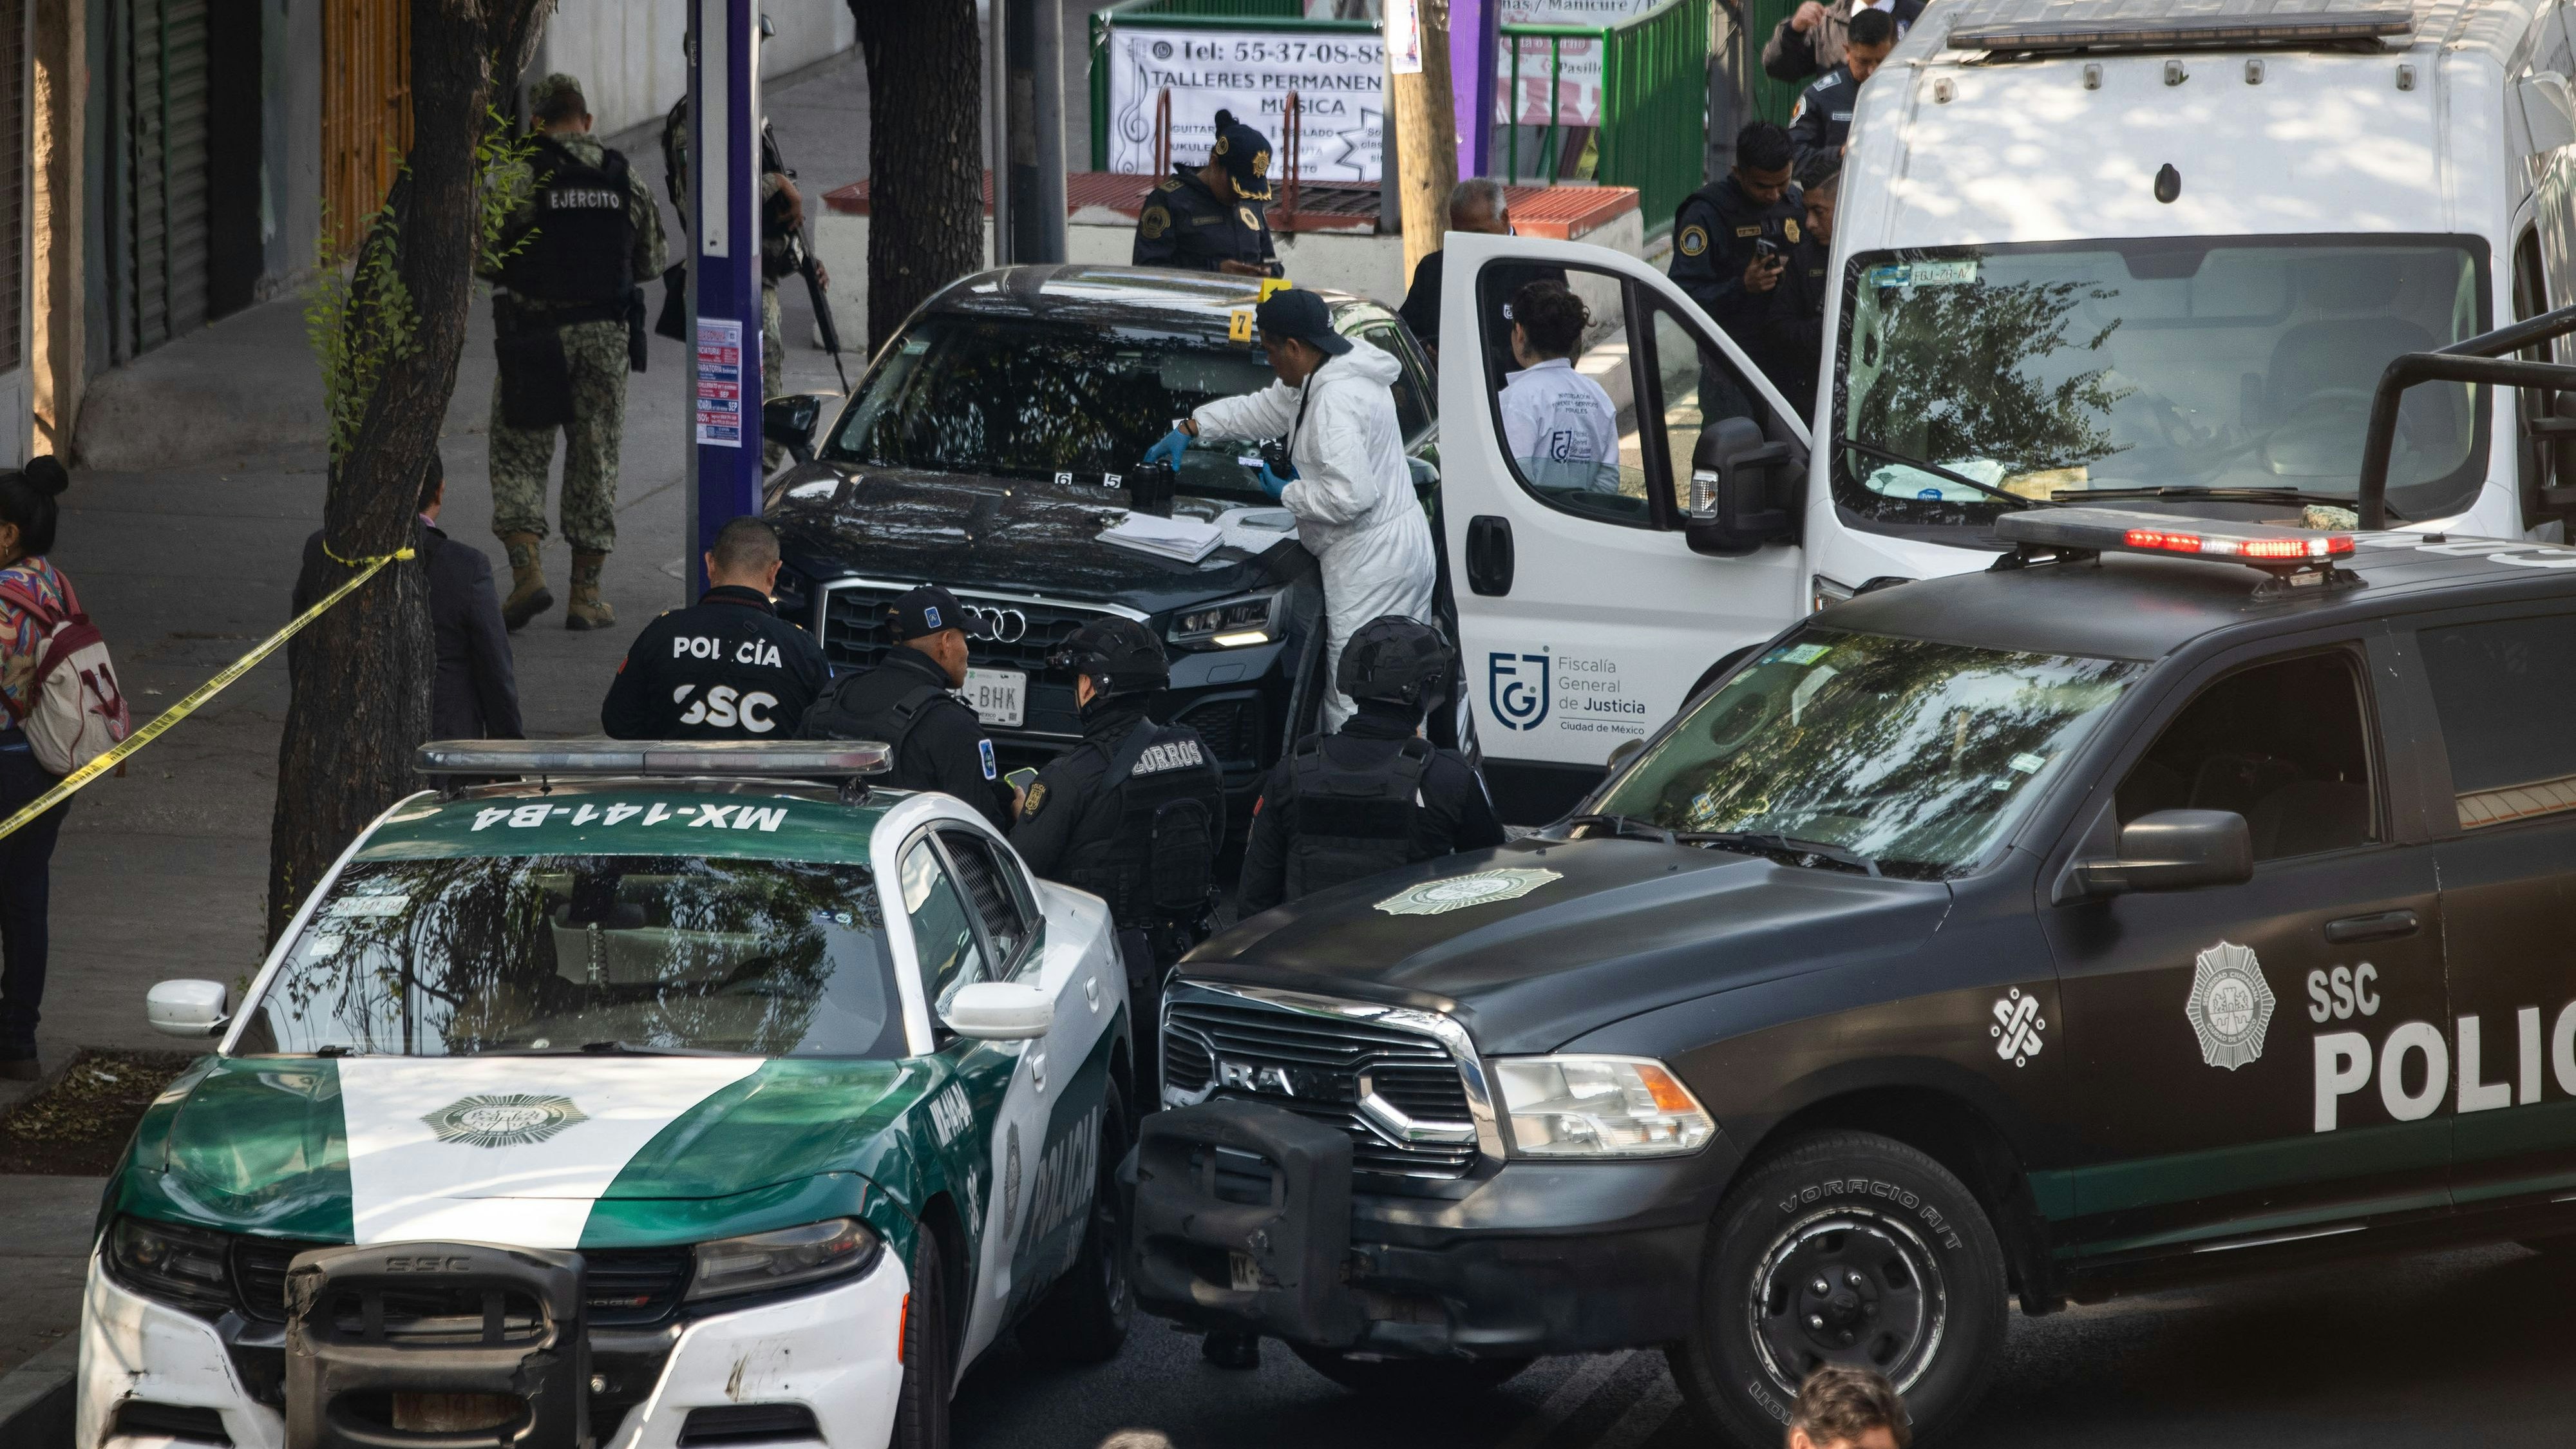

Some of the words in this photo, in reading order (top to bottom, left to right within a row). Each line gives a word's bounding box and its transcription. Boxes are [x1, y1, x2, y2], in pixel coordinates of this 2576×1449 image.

[1181, 41, 1224, 61] Tel:
[1151, 71, 1255, 88] TALLERES
[551, 189, 619, 208] EJÉRCITO
[1238, 315, 1246, 334] 7
[1057, 474, 1069, 484] 6
[1106, 475, 1119, 488] 5
[674, 636, 782, 668] POLCÍA
[1558, 656, 1616, 674] Fiscalía
[1558, 676, 1620, 693] General
[674, 684, 779, 733] SSC
[1558, 697, 1578, 710] de
[1584, 697, 1645, 714] Justicia
[1560, 721, 1594, 732] Ciudad
[1596, 723, 1609, 732] de
[1611, 724, 1645, 735] México
[471, 802, 790, 832] MX-141-B4
[2202, 972, 2228, 1007] SEGURIDAD
[2230, 972, 2259, 1003] CIUDADANA
[2307, 963, 2380, 1023] SSC
[2207, 1023, 2227, 1041] CIUDAD
[1220, 1061, 1320, 1097] RA
[1779, 1179, 1920, 1213] VORACIO
[1919, 1206, 1963, 1250] A/T
[386, 1256, 470, 1273] SSC
